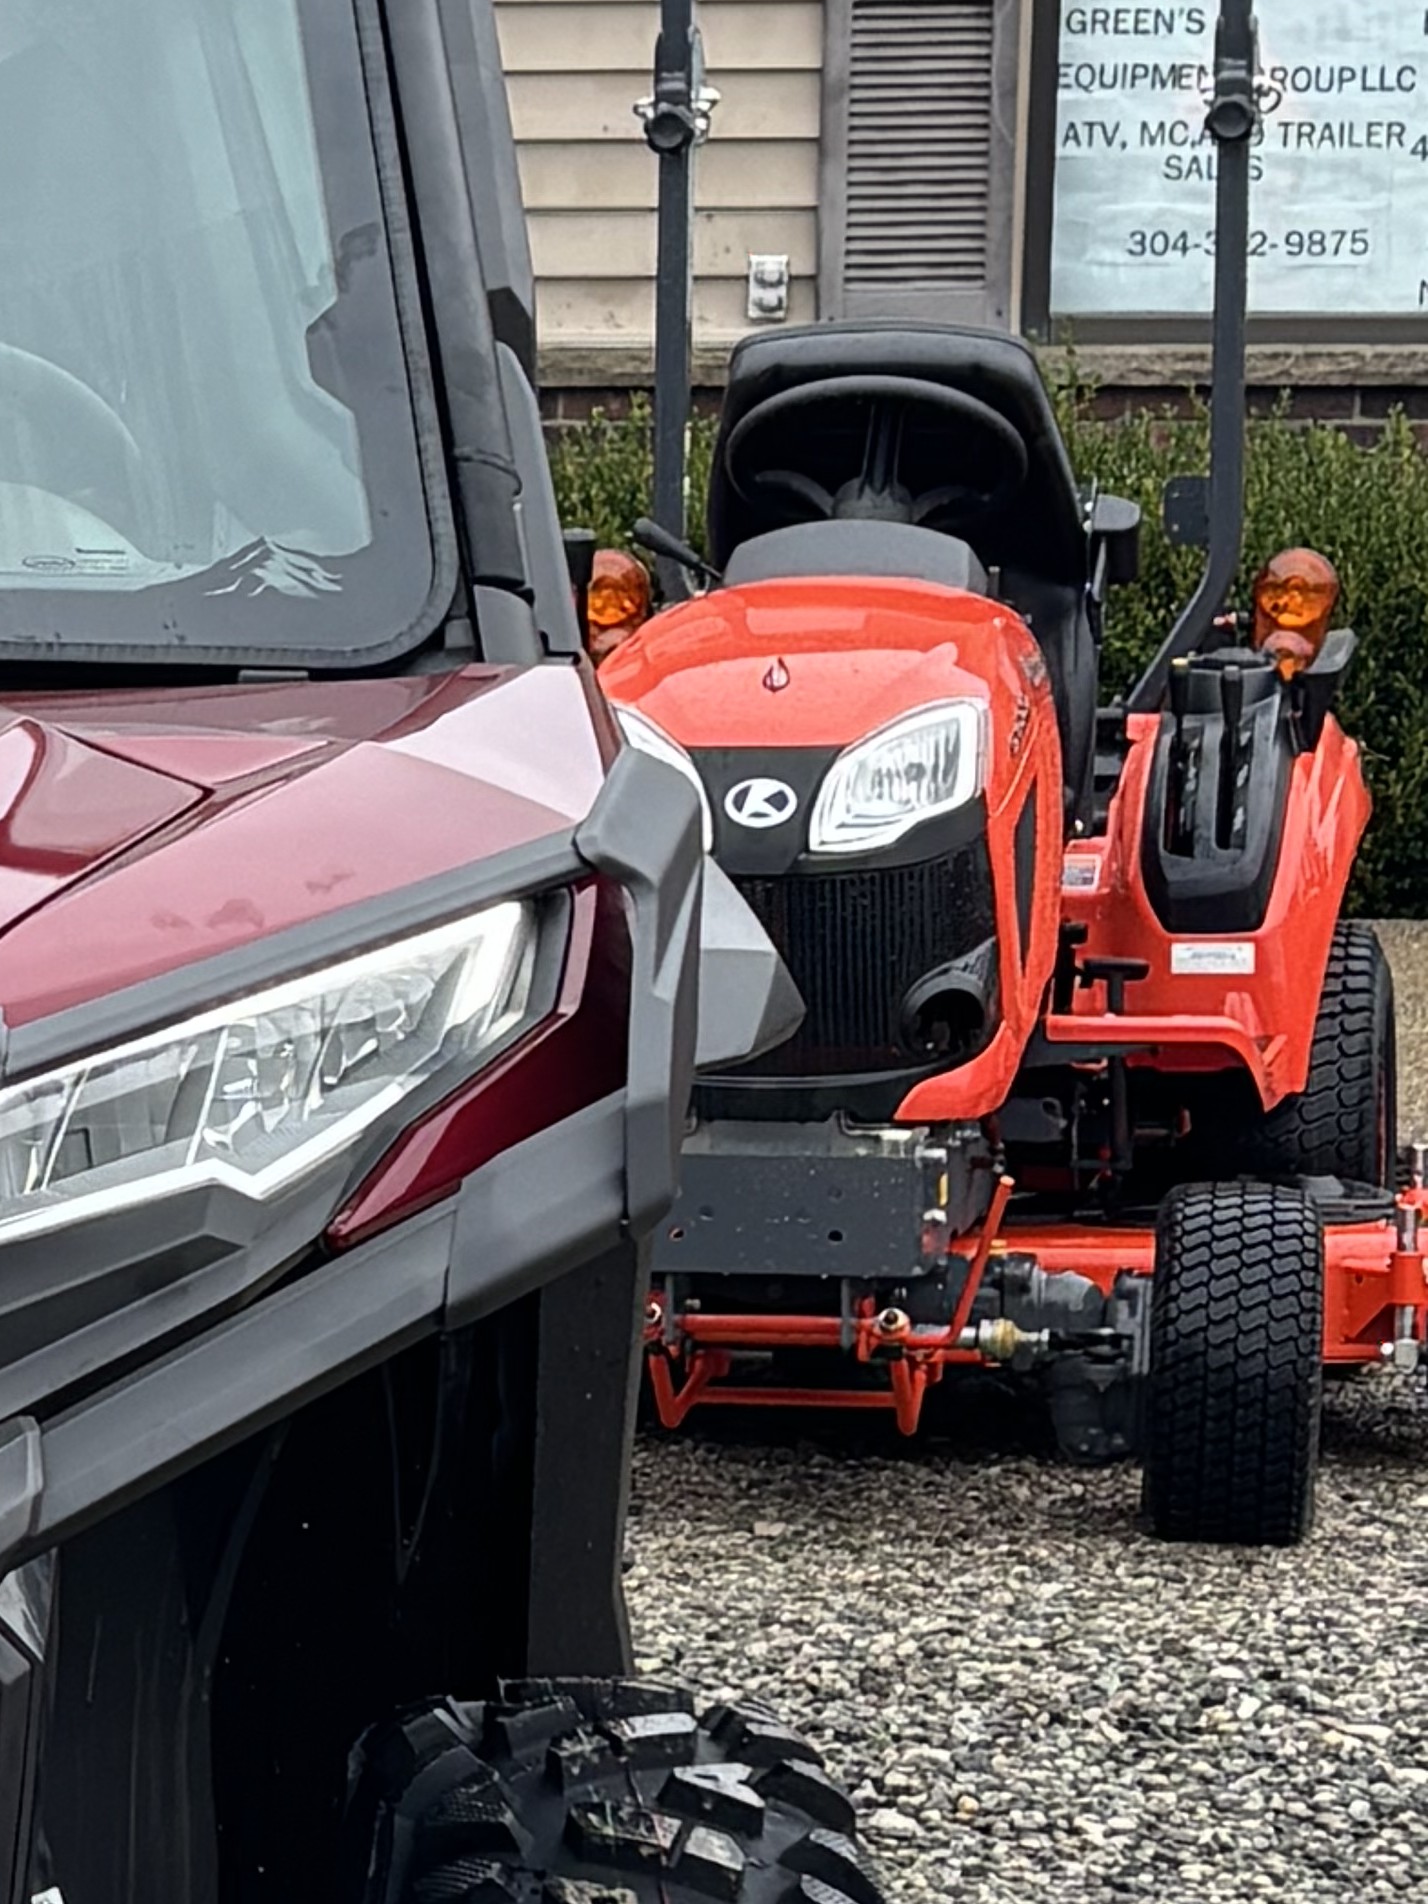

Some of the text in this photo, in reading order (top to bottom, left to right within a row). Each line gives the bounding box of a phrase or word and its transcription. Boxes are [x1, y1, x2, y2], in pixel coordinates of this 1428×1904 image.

[1065, 7, 1206, 35] GREEN'S
[1058, 62, 1218, 93] EQUIPME
[1063, 121, 1127, 151] ATV,
[1277, 121, 1406, 150] TRAILER
[1163, 154, 1264, 182] SALS
[1126, 228, 1369, 257] 304-32-9875
